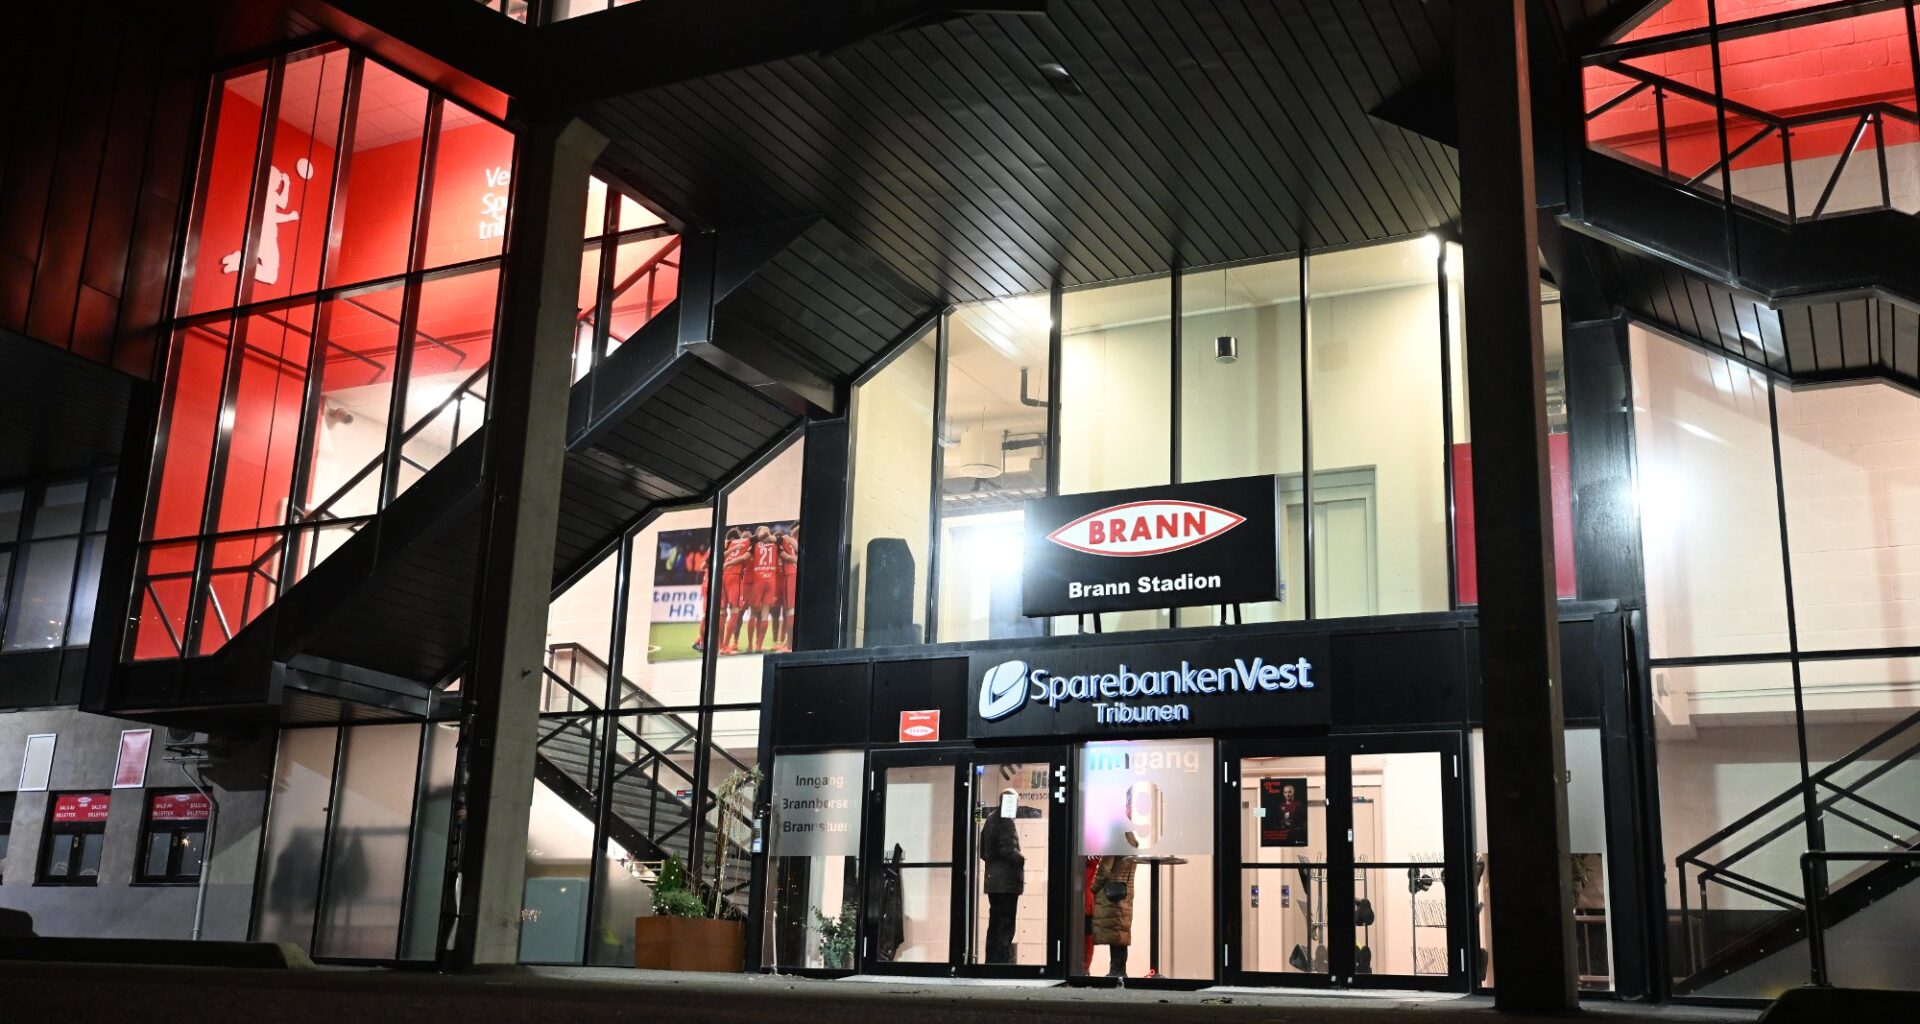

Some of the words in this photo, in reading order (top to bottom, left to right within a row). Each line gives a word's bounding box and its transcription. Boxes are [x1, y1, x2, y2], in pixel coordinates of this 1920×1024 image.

[1089, 510, 1206, 545] BRANN
[759, 547, 773, 566] 21
[1069, 580, 1131, 599] Brann
[1137, 573, 1221, 594] Stadion
[1092, 702, 1190, 725] Tribunen
[795, 774, 844, 789] Inngang
